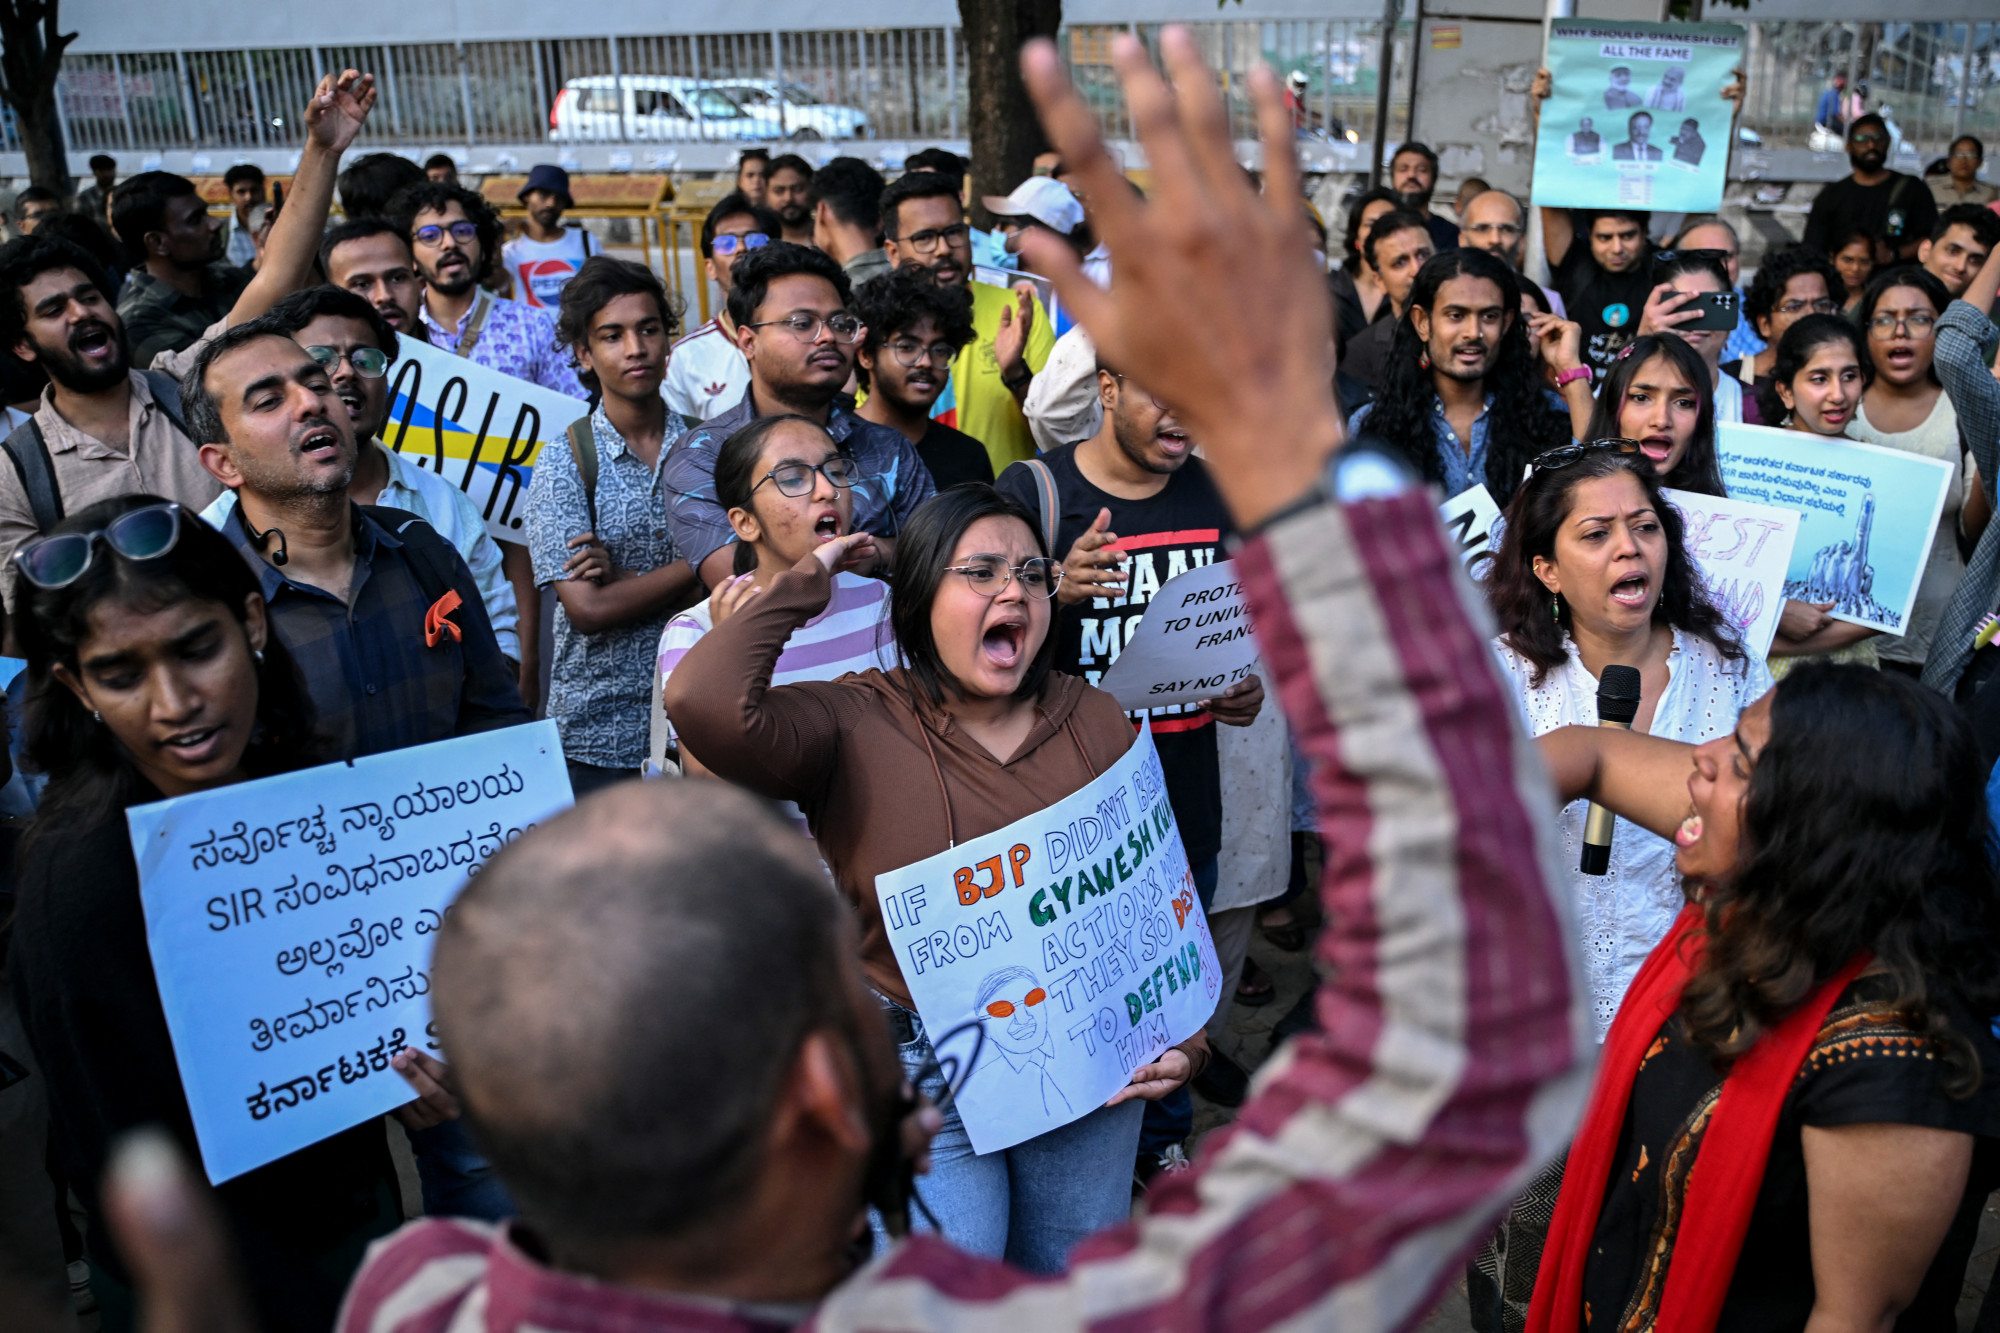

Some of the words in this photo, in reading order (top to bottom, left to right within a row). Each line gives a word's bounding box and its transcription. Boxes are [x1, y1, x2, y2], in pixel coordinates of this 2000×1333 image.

[1556, 27, 1587, 37] WHY
[1590, 29, 1643, 40] SHOULD
[1649, 31, 1710, 44] GYANESH
[1713, 36, 1737, 46] GET
[1602, 45, 1624, 55] ALL
[1629, 46, 1652, 57] THE
[1655, 48, 1689, 60] FAME
[1785, 462, 1826, 477] ಕರ್ನಾಟಕ
[1163, 617, 1190, 634] TO
[1149, 679, 1192, 695] SAY
[1193, 674, 1225, 690] NO
[1231, 663, 1251, 682] TO
[340, 763, 525, 841] ನ್ಯಾಯಾಲಯ
[206, 888, 266, 932] SIR
[885, 884, 927, 930] IF
[953, 843, 1031, 906] BJP
[909, 911, 1013, 975] FROM
[1029, 829, 1154, 928] GYANESH
[276, 917, 403, 978] ಅಲ್ಲವೋ
[1043, 867, 1162, 973] ACTIONS
[1047, 939, 1139, 1013] THEY
[1142, 911, 1172, 962] SO
[1068, 1009, 1117, 1057] TO
[1124, 941, 1200, 1027] DEFEND
[1116, 1014, 1170, 1075] HIM
